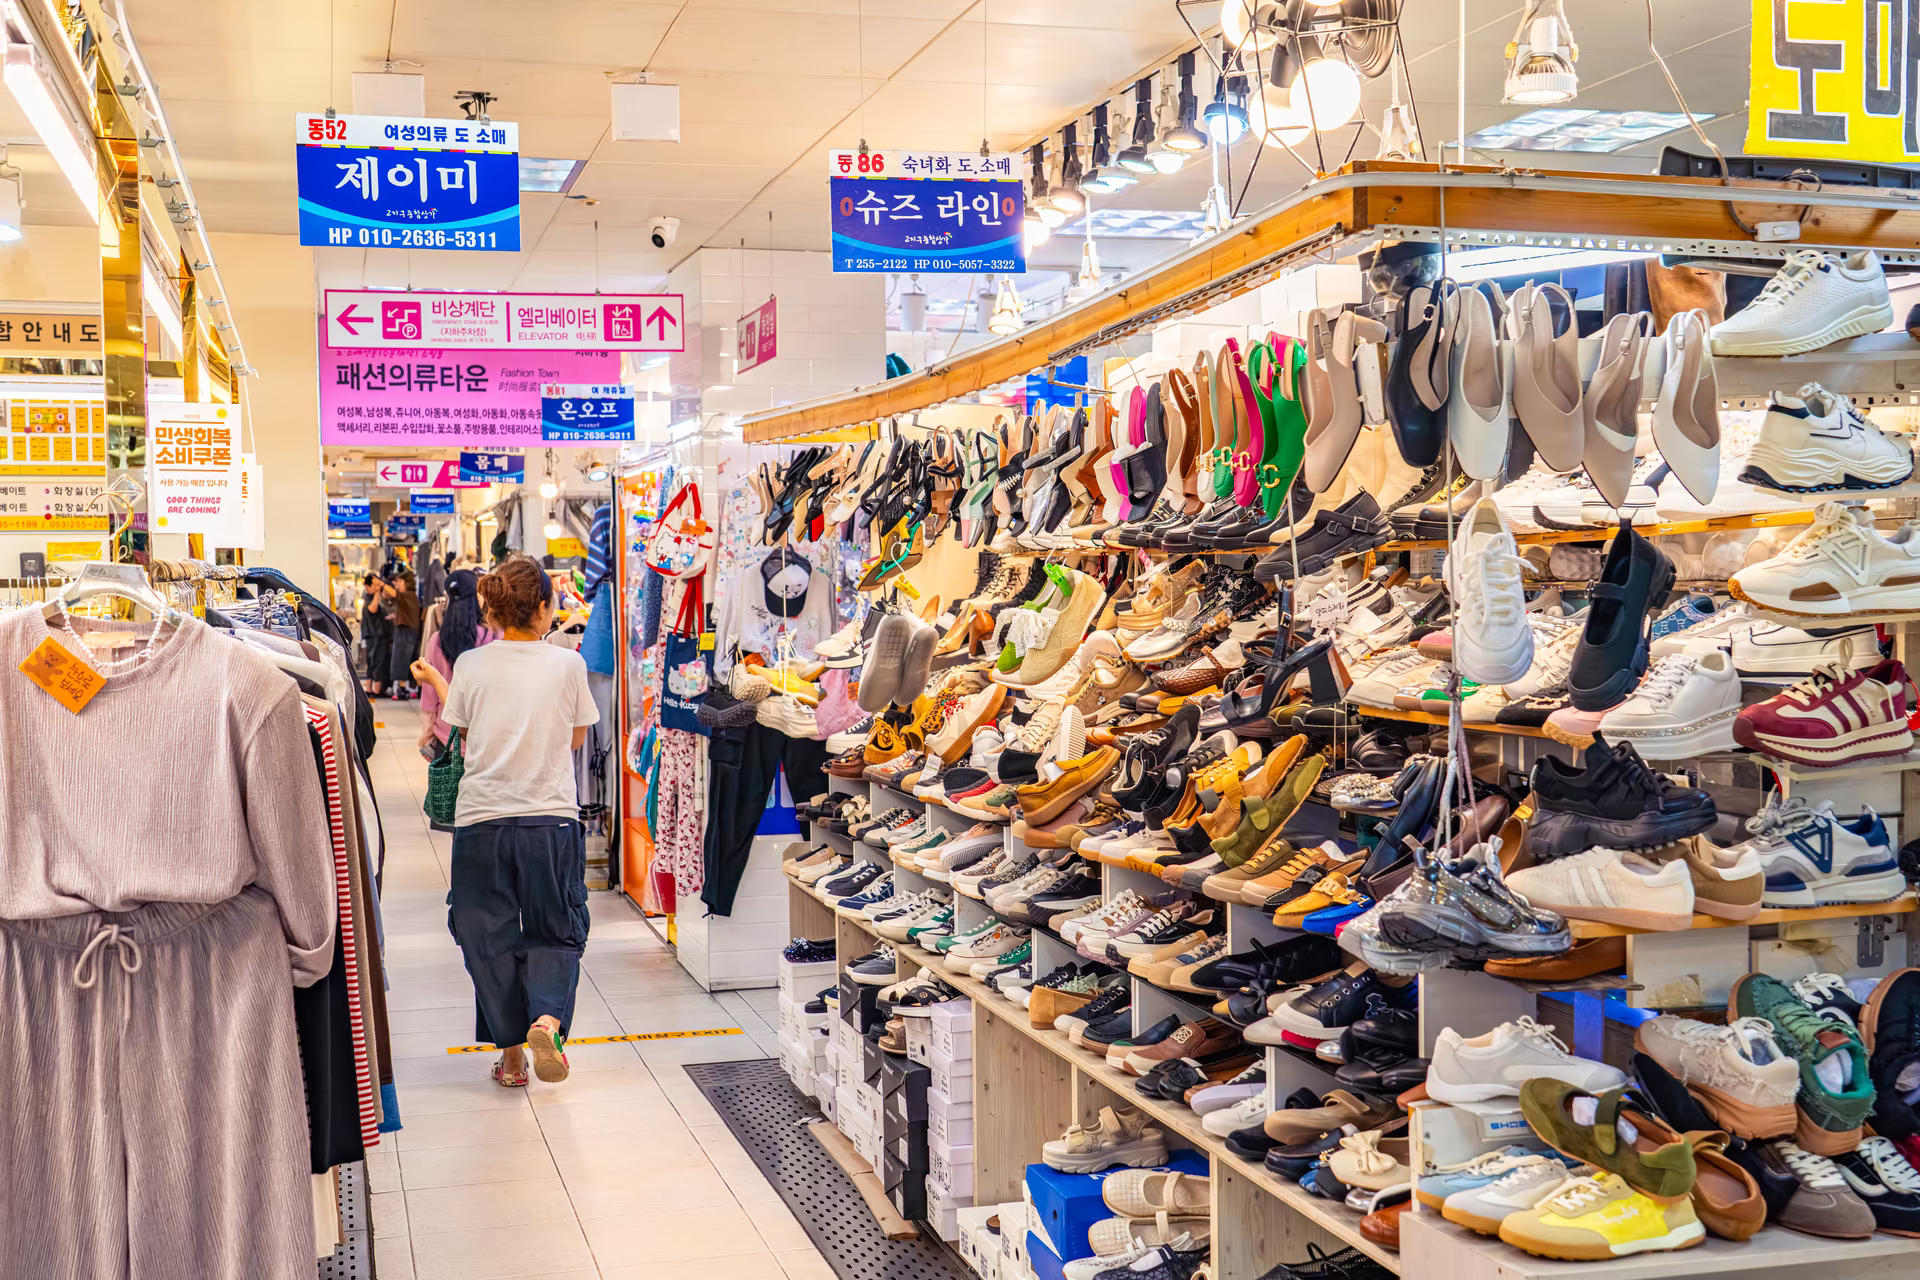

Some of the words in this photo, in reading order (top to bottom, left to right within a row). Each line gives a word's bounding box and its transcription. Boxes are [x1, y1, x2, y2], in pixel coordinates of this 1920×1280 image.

[308, 118, 347, 141] 동52
[384, 124, 448, 142] 여성의류
[455, 127, 470, 143] 도
[476, 128, 506, 145] 소매
[837, 154, 853, 173] 동
[857, 153, 885, 173] 86
[902, 156, 952, 175] 숙녀화
[335, 155, 478, 205] 제이미
[854, 189, 923, 226] 슈즈
[936, 190, 1002, 227] 라인
[328, 228, 353, 245] HP
[358, 228, 497, 248] 010-2636-5311
[844, 259, 854, 269] T
[855, 258, 908, 269] 255-2122
[913, 259, 930, 269] HP
[932, 259, 1015, 270] 010-5057-3322
[432, 300, 496, 318] 비상계단
[517, 307, 597, 329] 엘리베이터
[440, 327, 487, 337] (지하주차장)
[518, 332, 569, 341] ELEVATOR
[576, 332, 597, 342] 电梯
[336, 361, 489, 393] 패션의류타운
[501, 367, 535, 379] Fashion
[537, 368, 560, 379] Town
[557, 400, 619, 421] 온오프
[155, 427, 232, 446] 민생회복
[548, 431, 561, 440] HP
[563, 431, 631, 440] 010-2636-5311
[155, 447, 232, 466] 소비쿠폰
[159, 478, 174, 487] 사용
[175, 478, 190, 487] 가능
[190, 479, 205, 488] 매장
[206, 479, 228, 488] 입니다
[166, 496, 188, 504] GOOD
[189, 496, 222, 505] THINGS
[167, 506, 183, 514] ARE
[185, 506, 221, 515] COMING!
[65, 661, 94, 690] 눈으로
[59, 678, 84, 703] 보세요
